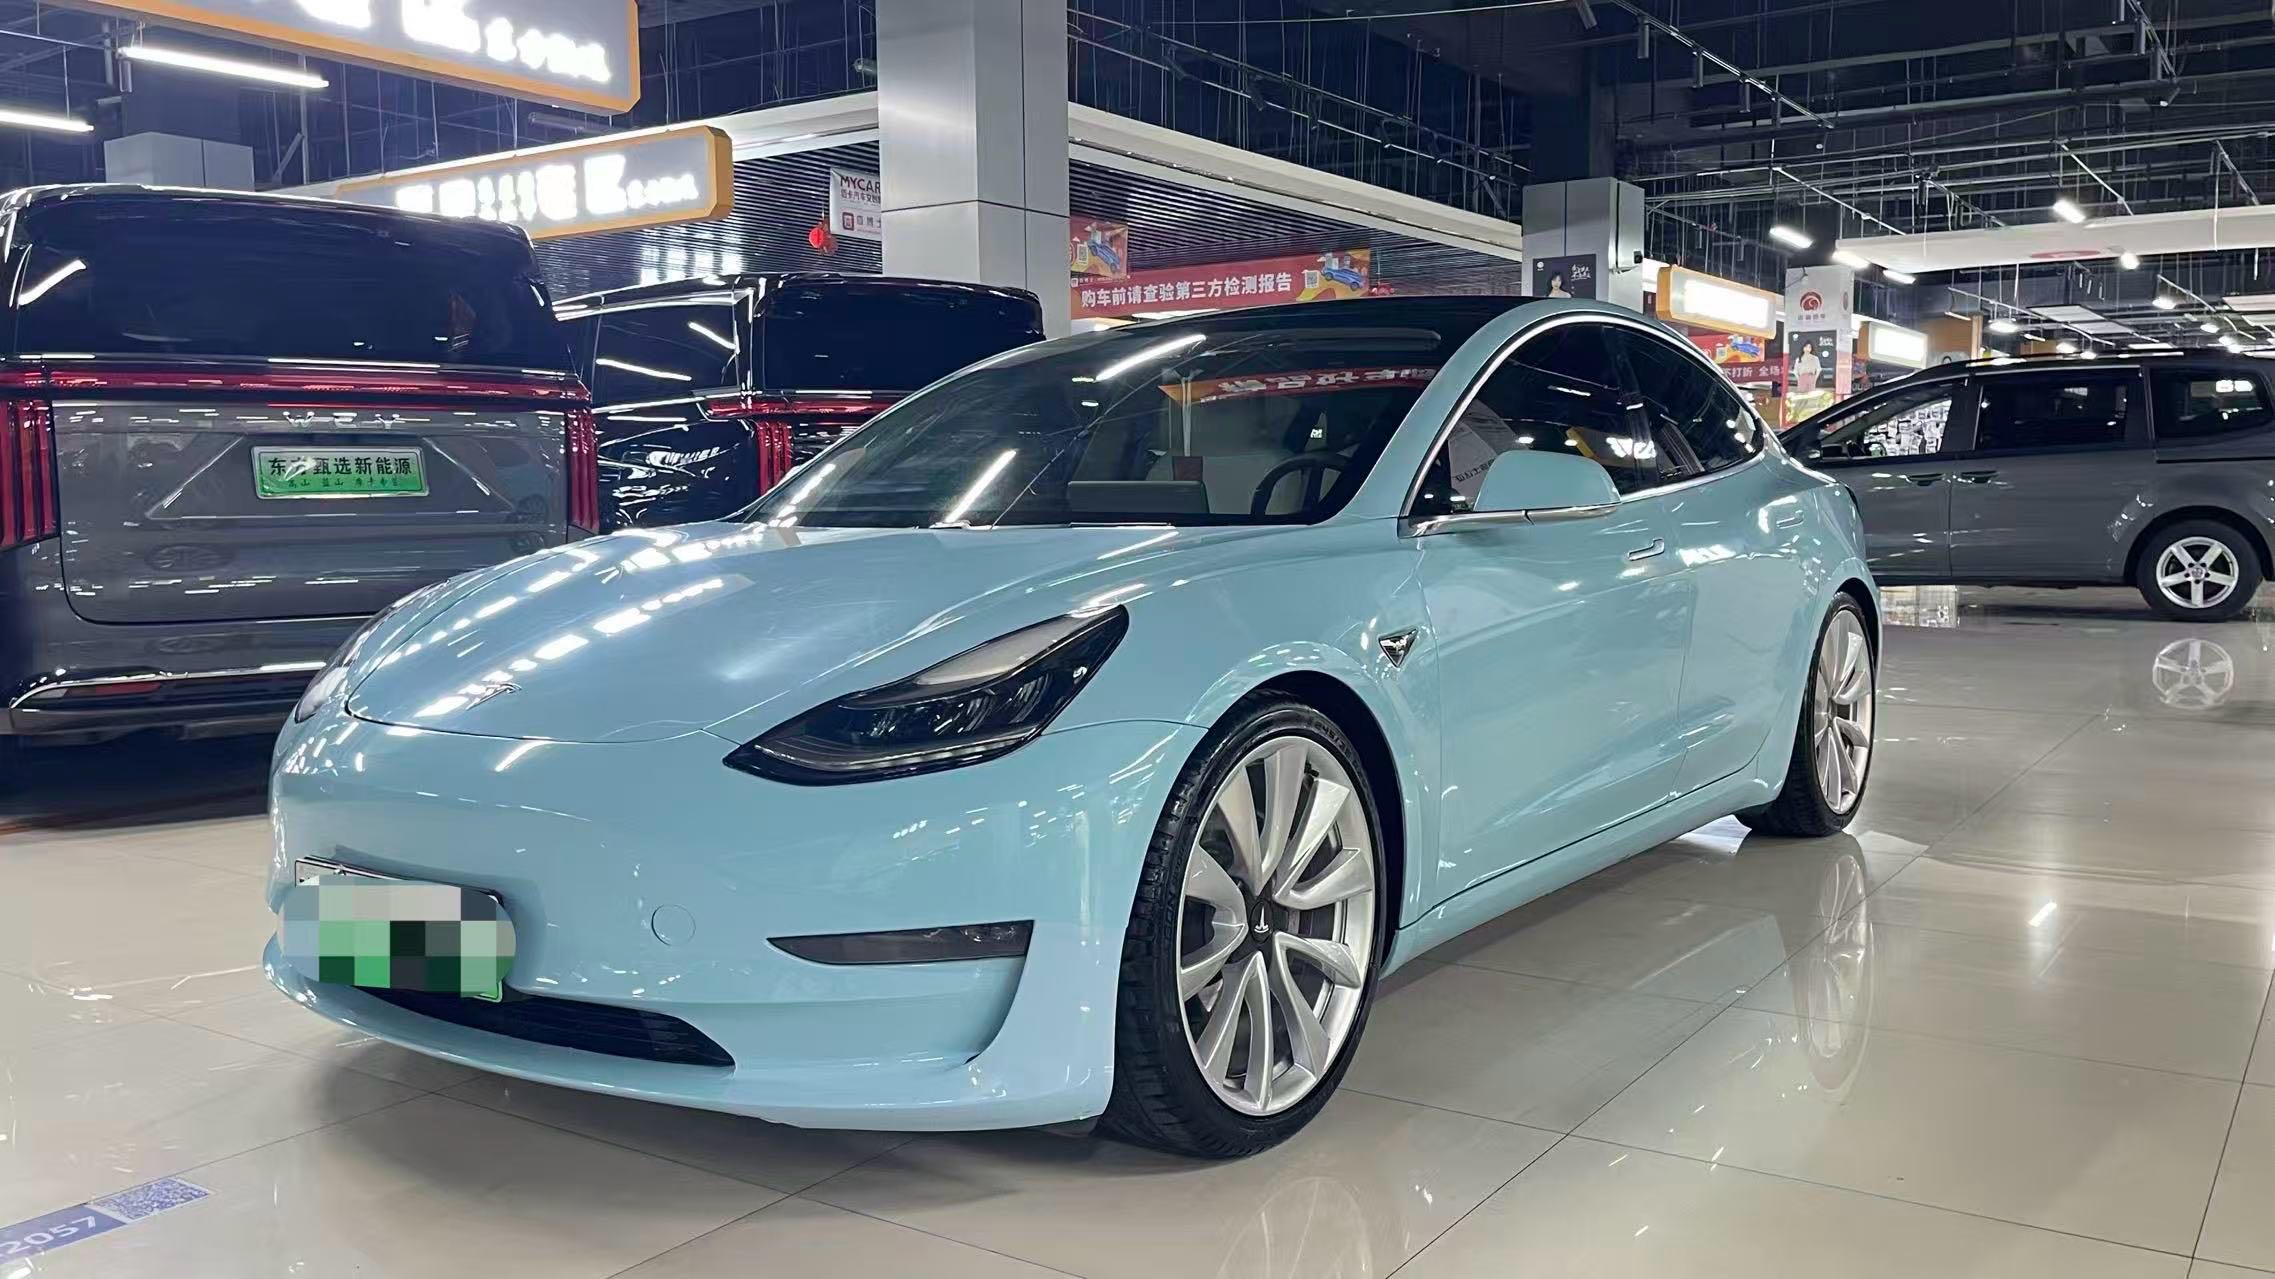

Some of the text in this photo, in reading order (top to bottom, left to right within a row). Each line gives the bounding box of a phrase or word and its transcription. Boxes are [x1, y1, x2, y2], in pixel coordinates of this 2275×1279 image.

[840, 176, 880, 193] MYCAR
[1081, 271, 1292, 307] 购车前请查验第三方检测报告
